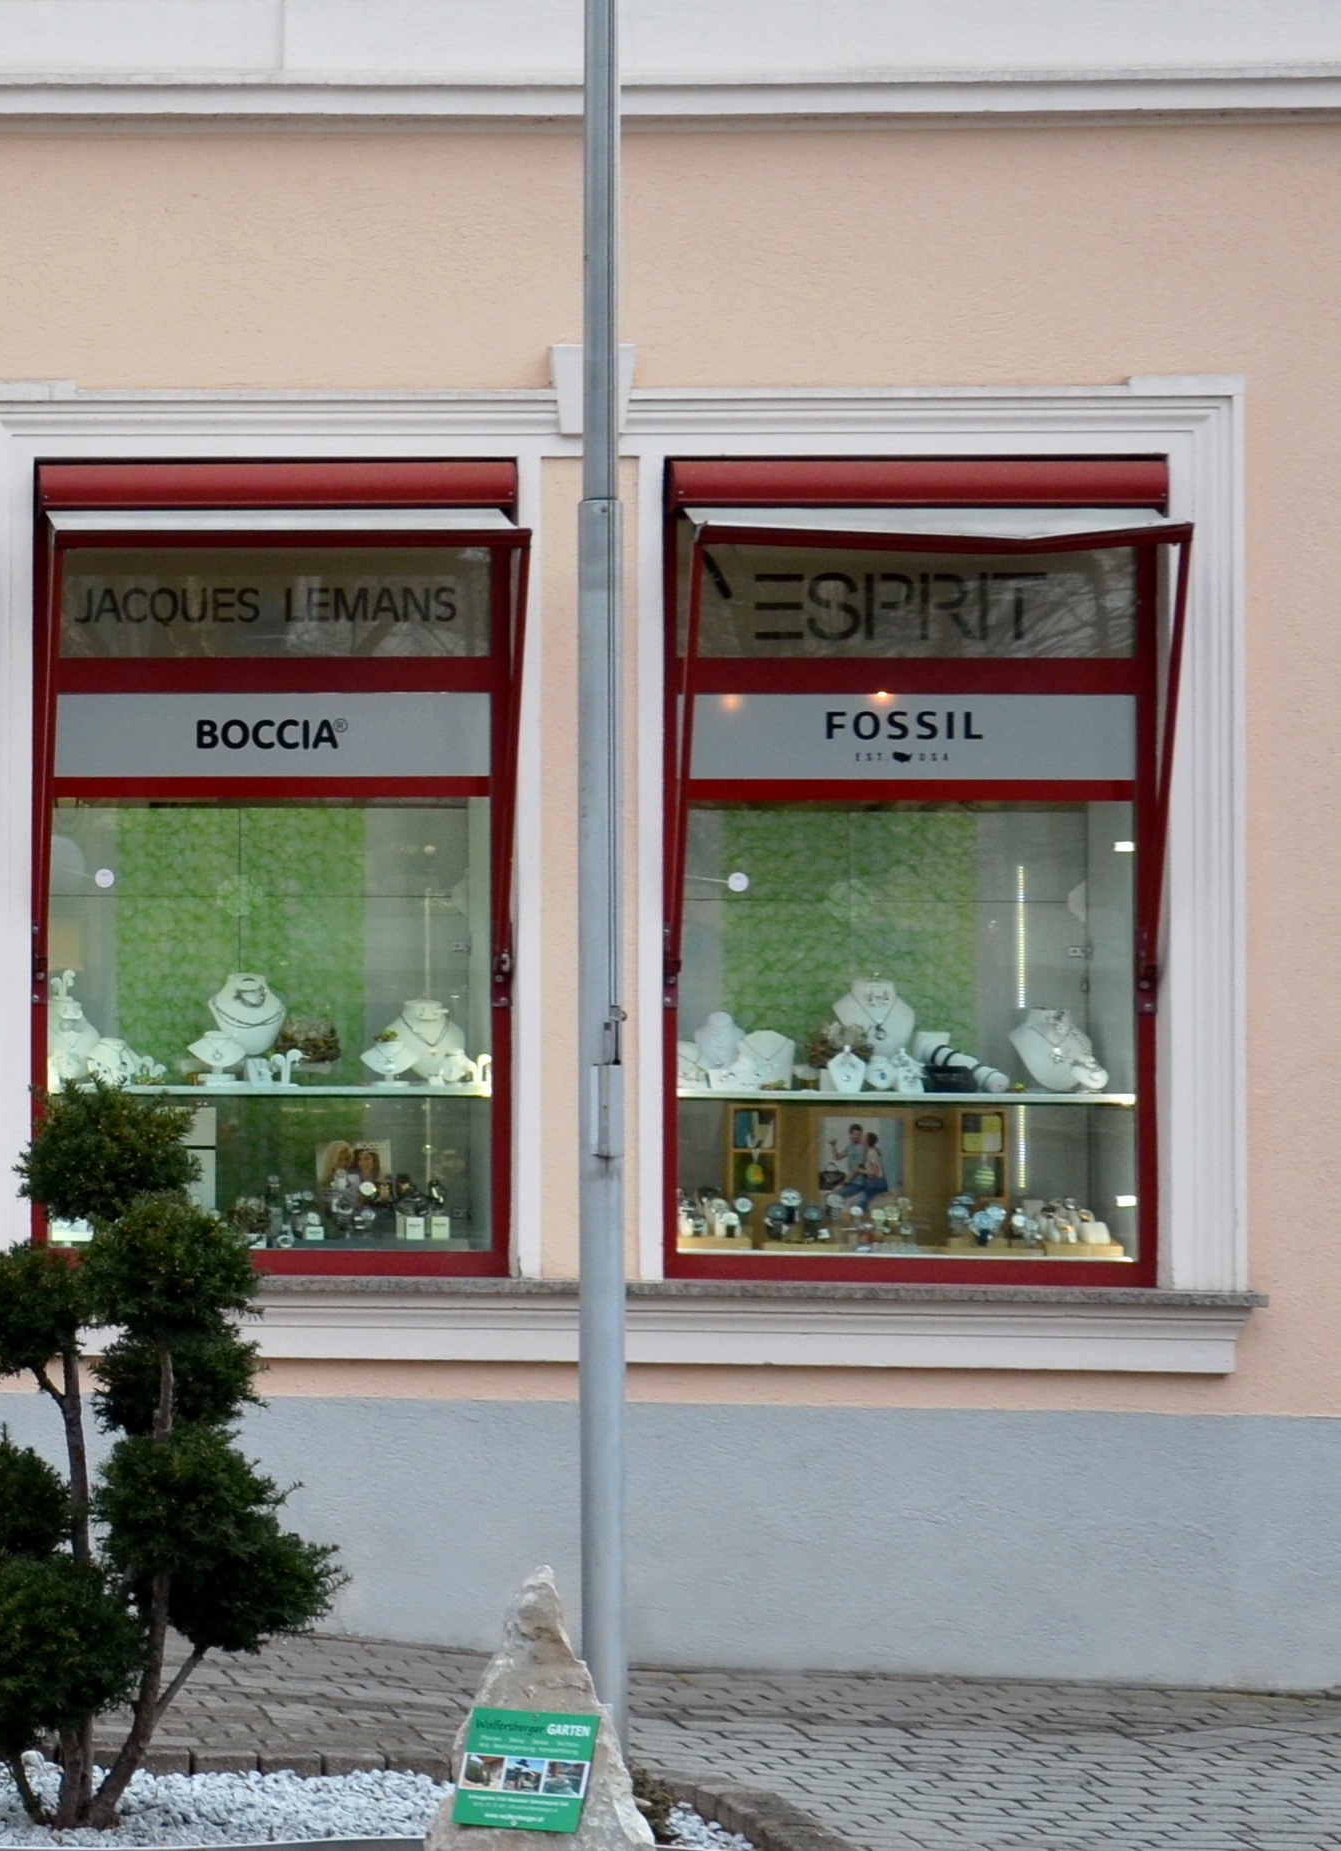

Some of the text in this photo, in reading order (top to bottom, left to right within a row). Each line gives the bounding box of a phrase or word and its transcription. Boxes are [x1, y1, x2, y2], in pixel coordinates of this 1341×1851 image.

[74, 586, 457, 628] JACQUES LEMANS
[754, 571, 1048, 641] ESPRIT
[825, 710, 984, 740] FOSSIL
[546, 1723, 591, 1738] GARTEN
